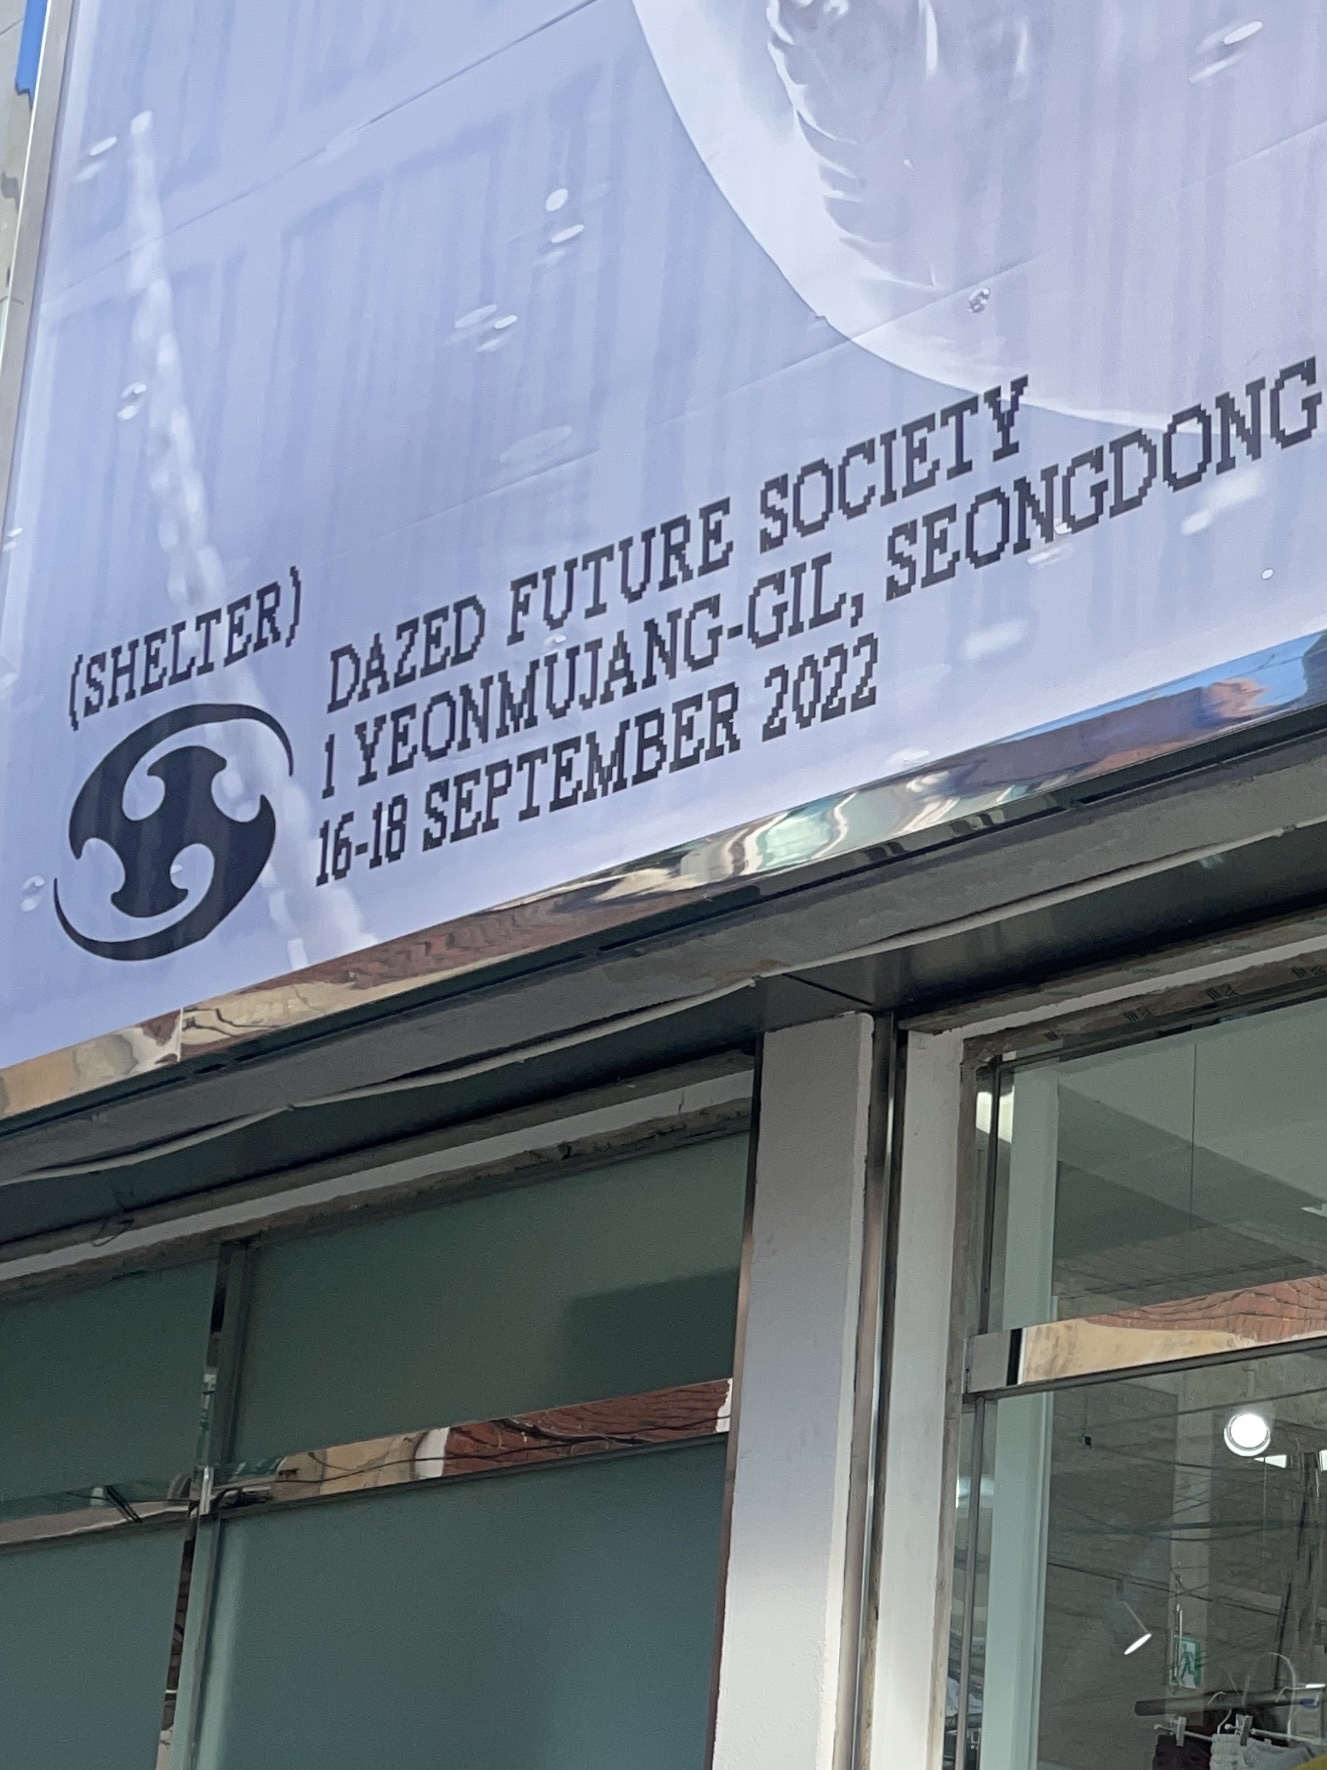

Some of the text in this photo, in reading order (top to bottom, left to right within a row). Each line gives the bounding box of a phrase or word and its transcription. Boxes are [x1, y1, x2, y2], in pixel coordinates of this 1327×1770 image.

[69, 566, 301, 731] (SHELTER)
[327, 375, 1028, 714] DAZED FUTURE SOCIETY
[316, 633, 878, 886] 16-18 SEPTEMBER 2022
[322, 734, 336, 799] 1
[355, 552, 863, 786] YEONMUJANG-GIL,
